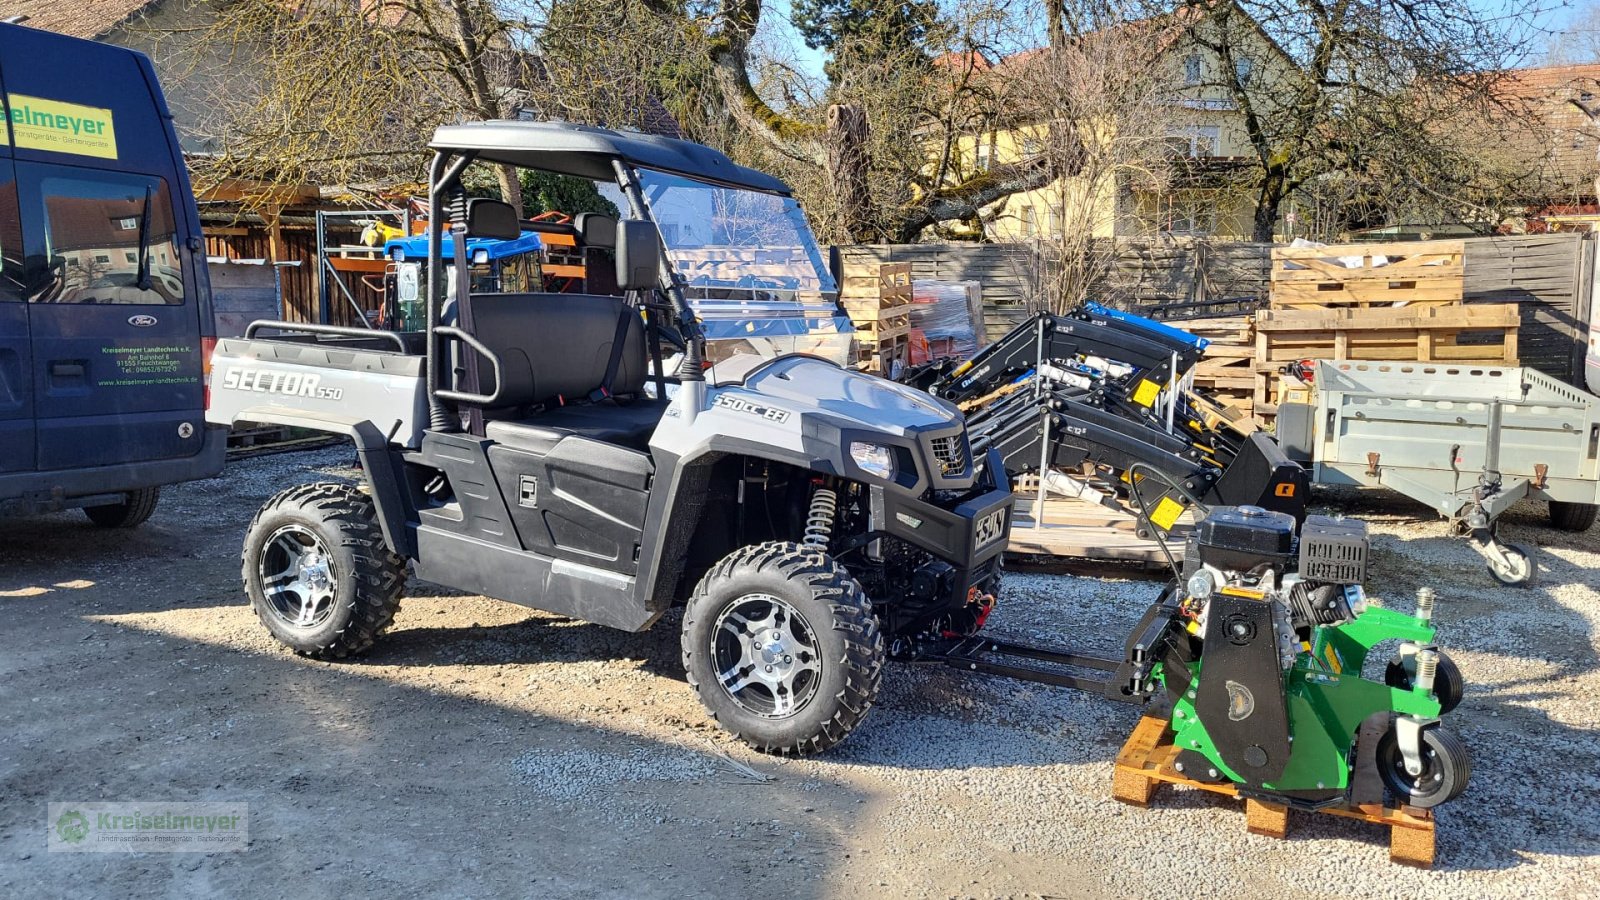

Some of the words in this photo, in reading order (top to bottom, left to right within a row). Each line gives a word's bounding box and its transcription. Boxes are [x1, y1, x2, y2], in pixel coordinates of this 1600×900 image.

[102, 346, 142, 354] Kreiselmeyer
[140, 353, 164, 361] Bahnhof
[223, 367, 321, 398] SECTOR
[317, 387, 343, 401] 550
[762, 407, 791, 425] EFI
